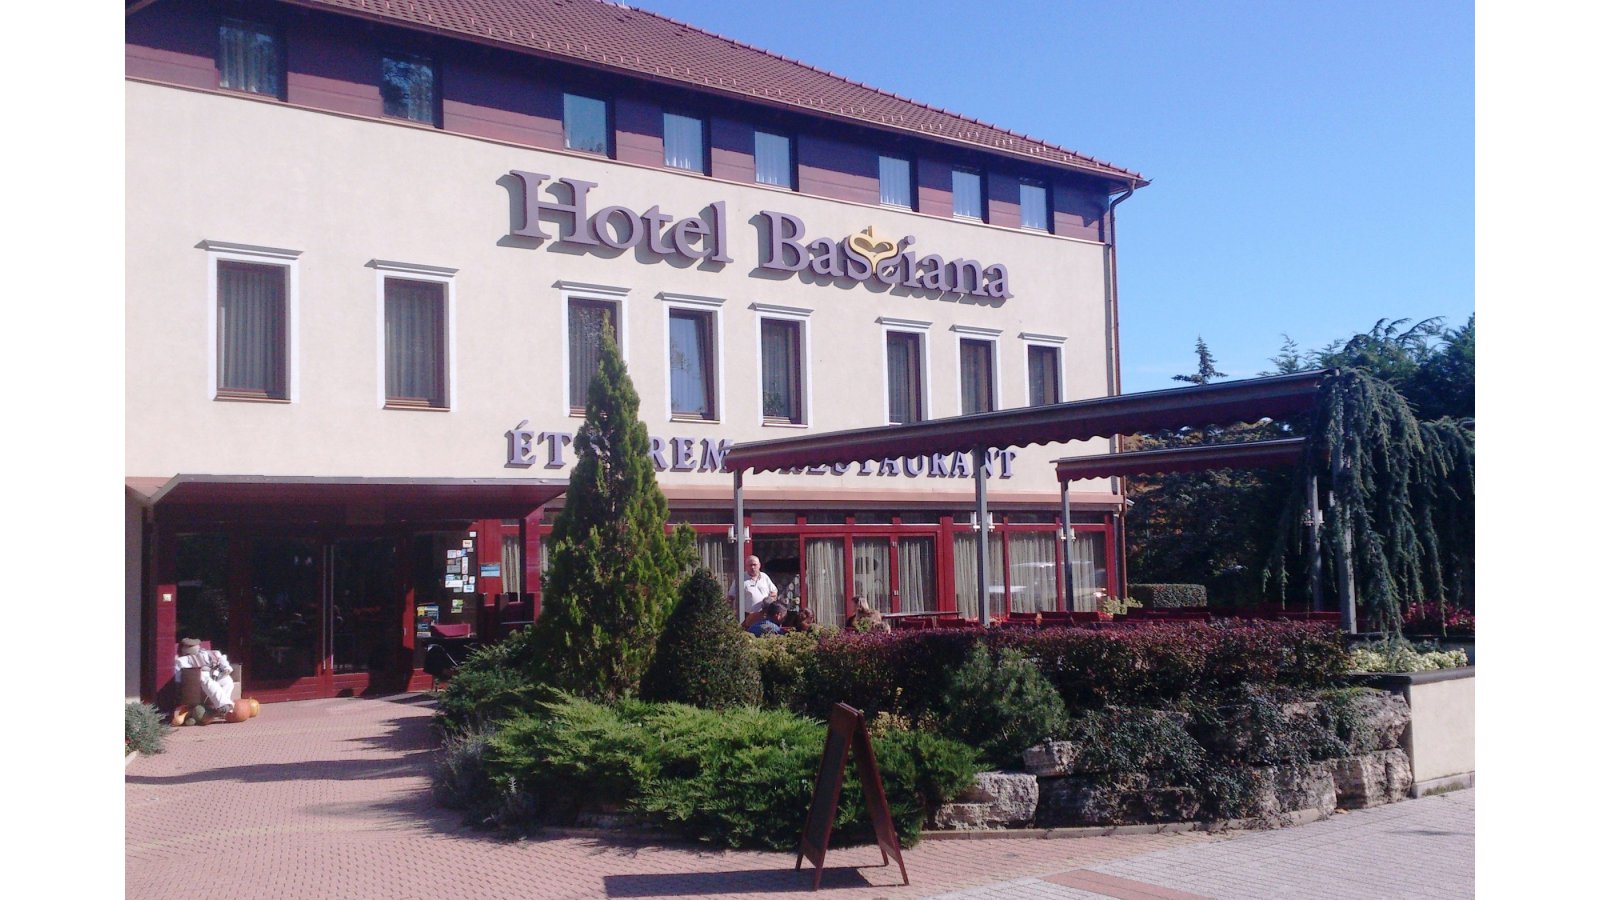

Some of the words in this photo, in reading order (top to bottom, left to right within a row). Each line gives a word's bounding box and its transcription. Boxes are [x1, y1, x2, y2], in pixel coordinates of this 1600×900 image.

[509, 169, 734, 264] Hotel
[508, 419, 736, 471] ÉTREM
[780, 449, 1017, 477] AURANT
